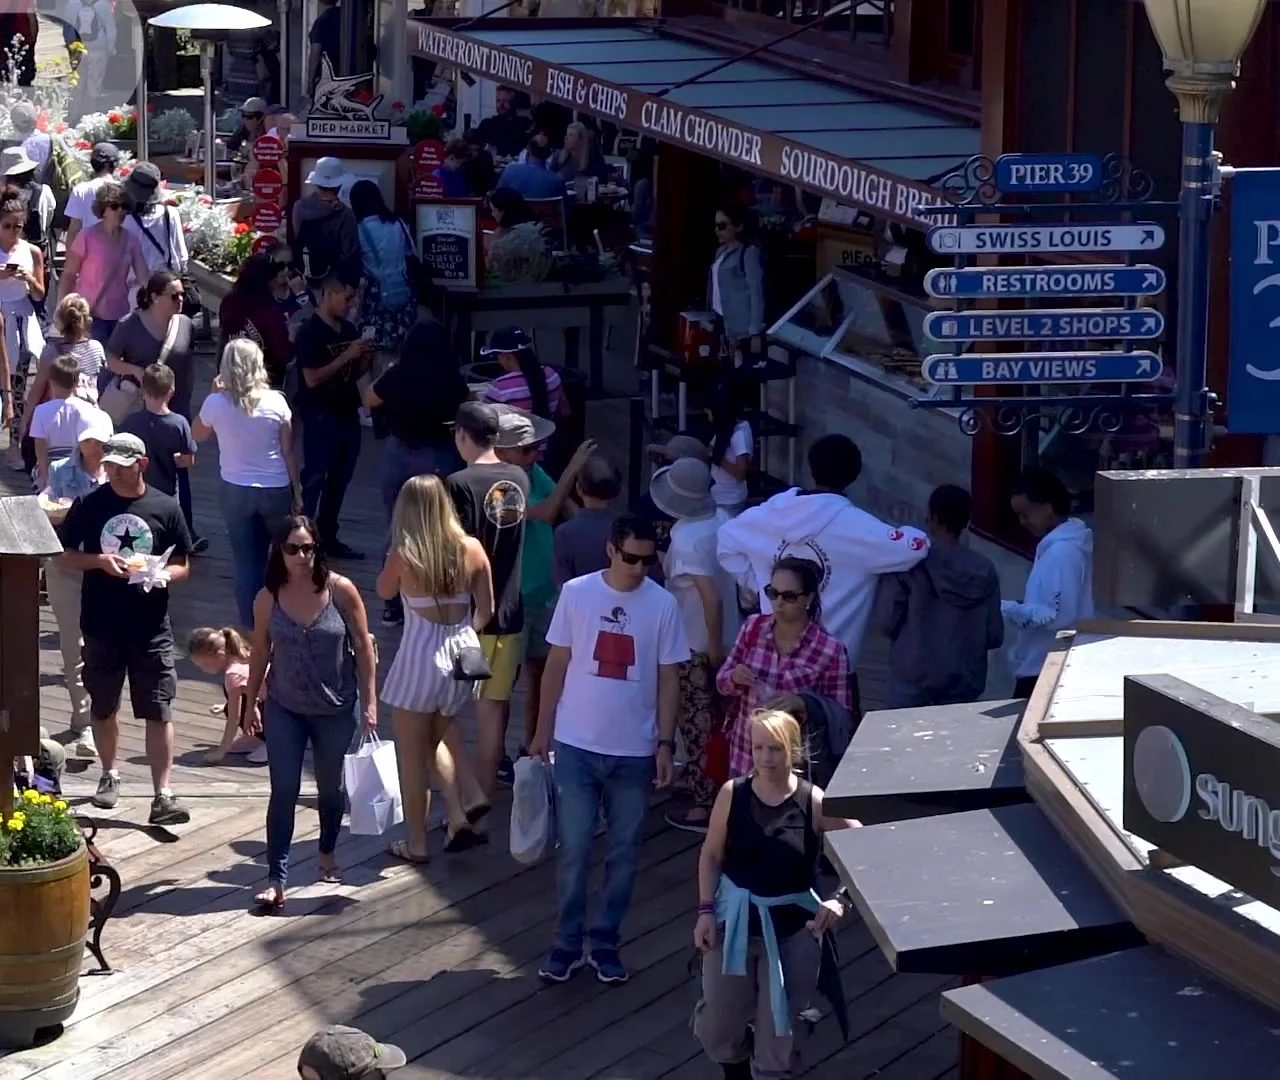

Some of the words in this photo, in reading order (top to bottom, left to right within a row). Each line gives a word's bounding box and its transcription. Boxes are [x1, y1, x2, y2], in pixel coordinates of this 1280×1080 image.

[311, 122, 337, 133] PIER
[340, 123, 386, 135] MARKET
[418, 28, 490, 73] WATERFRONT
[489, 49, 533, 86] DINING
[546, 68, 573, 101] FISH
[576, 78, 587, 104] &
[589, 83, 628, 119] CHIPS
[641, 100, 683, 139] CLAM
[684, 114, 762, 165] CHOWDER
[780, 145, 892, 210] SOURDOUGH
[1009, 163, 1065, 185] PIER
[1067, 163, 1093, 185] 39
[975, 231, 1041, 249] SWISS
[1048, 230, 1112, 248] LOUIS
[983, 273, 1115, 292] RESTROOMS
[969, 318, 1037, 336] LEVEL
[1040, 317, 1053, 335] 2
[1058, 316, 1131, 335] SHOPS
[982, 361, 1023, 379] BAY
[1030, 360, 1097, 378] VIEWS
